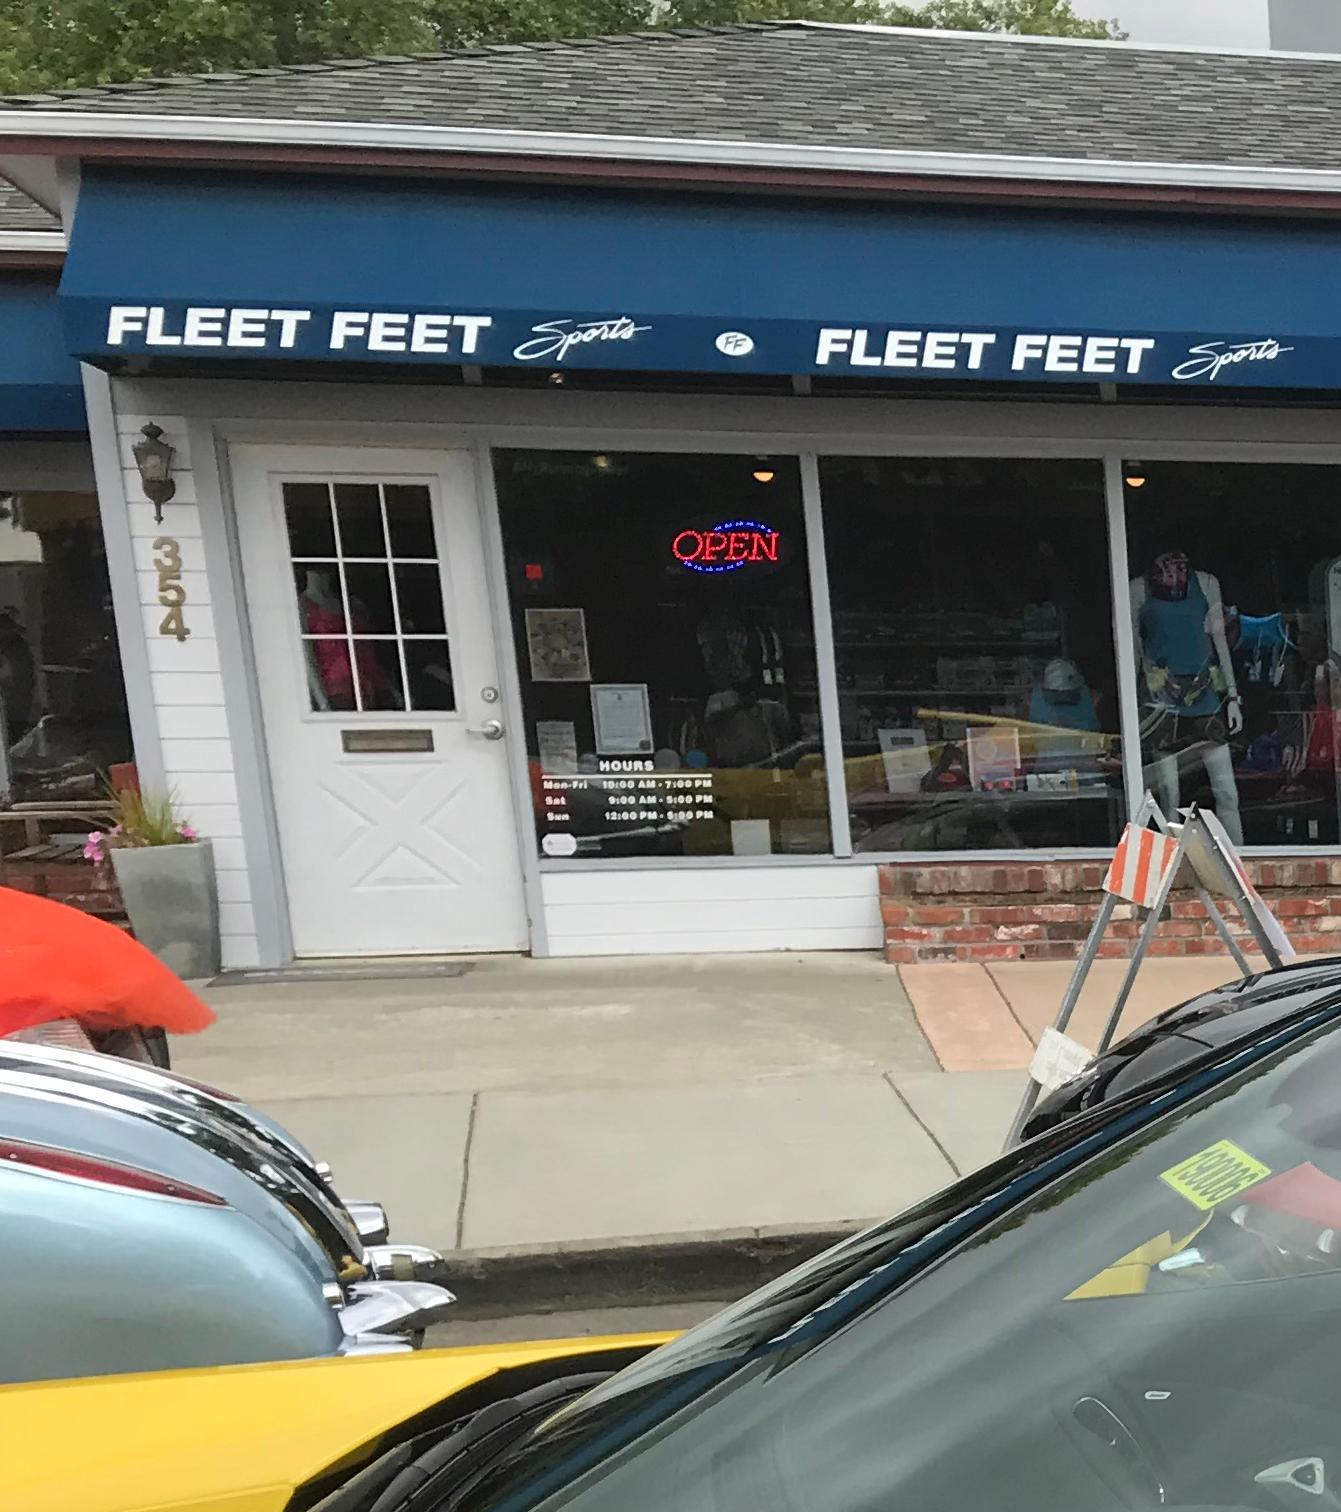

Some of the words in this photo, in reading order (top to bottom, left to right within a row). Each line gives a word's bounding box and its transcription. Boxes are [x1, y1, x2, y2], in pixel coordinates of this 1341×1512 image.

[106, 306, 311, 348] FLEET
[329, 311, 492, 354] FEET
[512, 315, 654, 362] Sports
[815, 328, 997, 370] FLEET
[1011, 334, 1156, 374] FEET
[1171, 337, 1296, 382] Sports
[671, 529, 779, 562] OPEN
[151, 536, 191, 643] 354
[599, 760, 654, 772] HOURS
[638, 779, 656, 789] AM
[695, 779, 713, 788] PM
[639, 795, 657, 805] AM
[696, 794, 713, 804] PM
[640, 811, 658, 820] PM
[696, 810, 714, 820] PM
